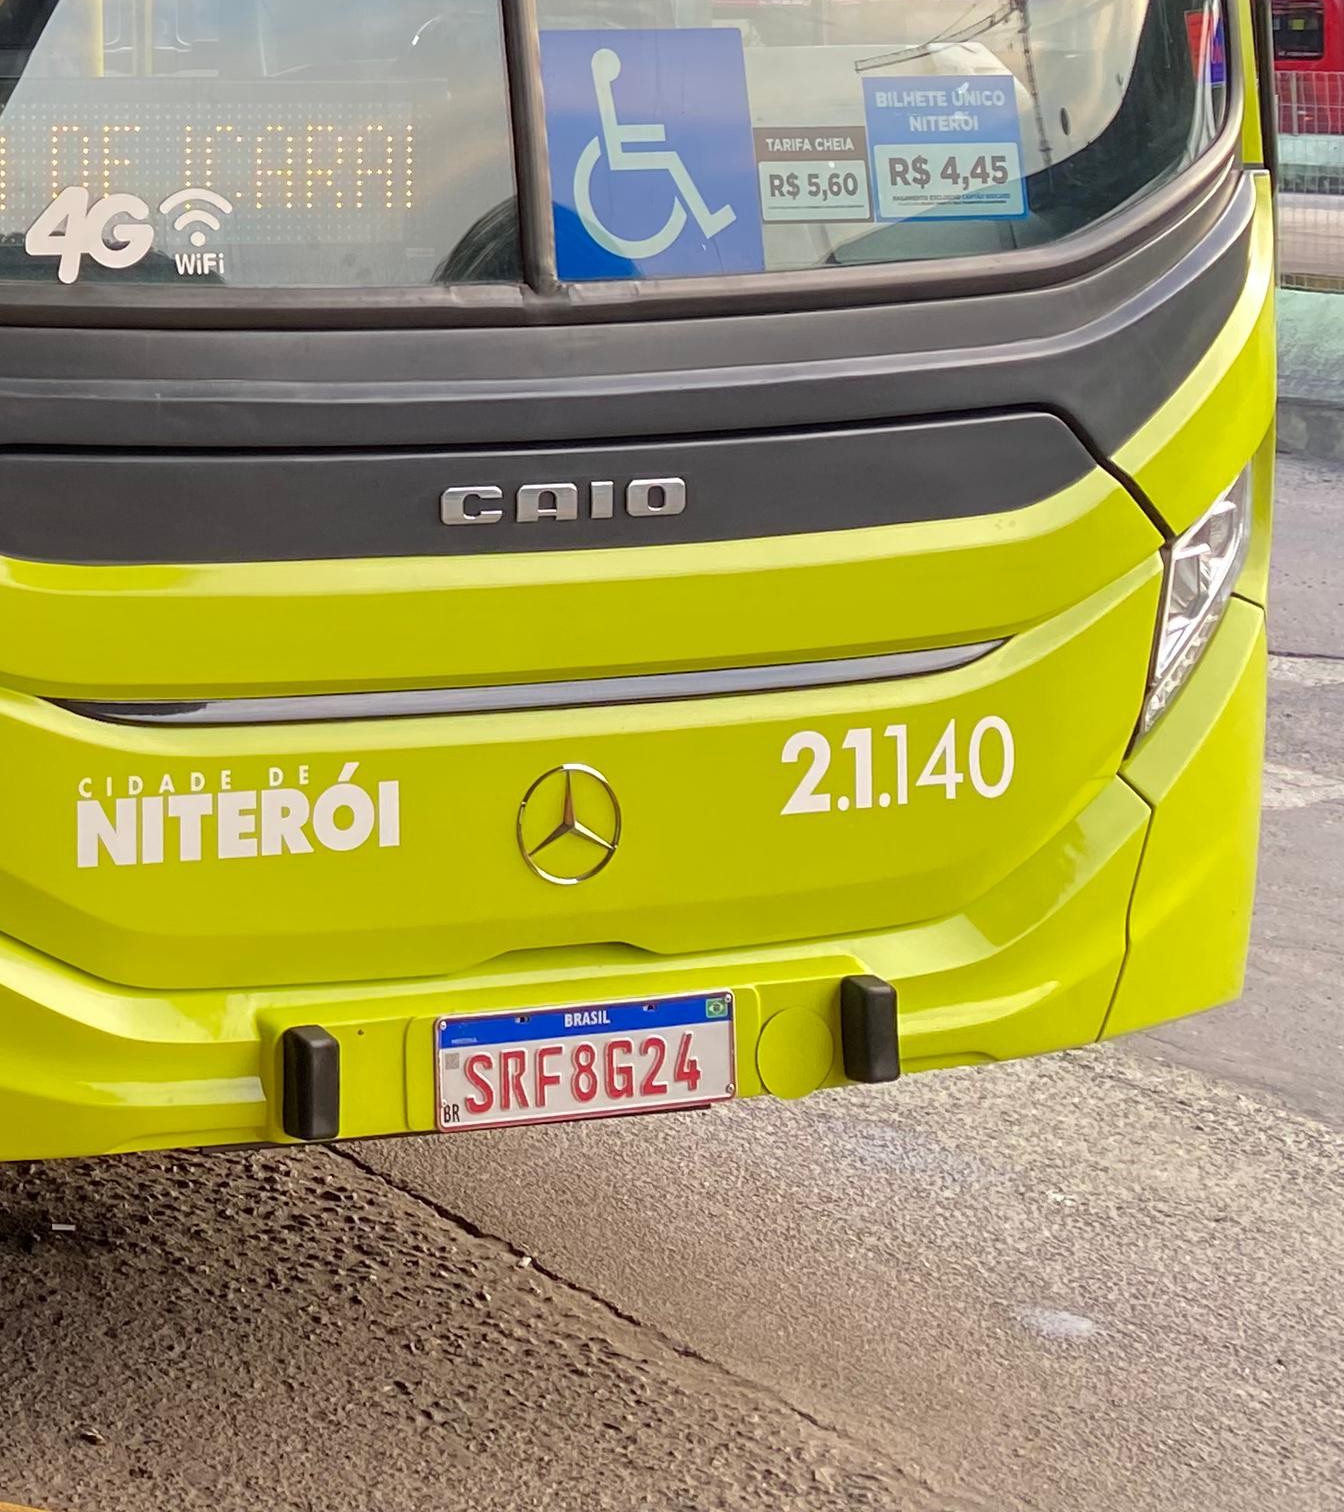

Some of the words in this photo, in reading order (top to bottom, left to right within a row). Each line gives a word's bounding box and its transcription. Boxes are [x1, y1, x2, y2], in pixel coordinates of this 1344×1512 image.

[875, 90, 946, 108] BILHETE
[766, 138, 812, 153] TARIFA
[815, 137, 855, 152] CHEIA
[769, 172, 800, 200] R$
[807, 172, 858, 201] 5,60
[888, 154, 931, 188] R$
[941, 155, 1009, 190] 4,45
[25, 187, 154, 284] 4G
[175, 252, 225, 276] WiFi
[441, 477, 686, 526] CAIO
[78, 767, 233, 799] CIDADE
[268, 764, 310, 787] DE
[780, 715, 1015, 816] 2.1.140
[77, 761, 401, 868] NITERÓI
[564, 1009, 611, 1028] BRASIL
[464, 1030, 702, 1115] SRF8G24
[443, 1103, 461, 1124] BR
